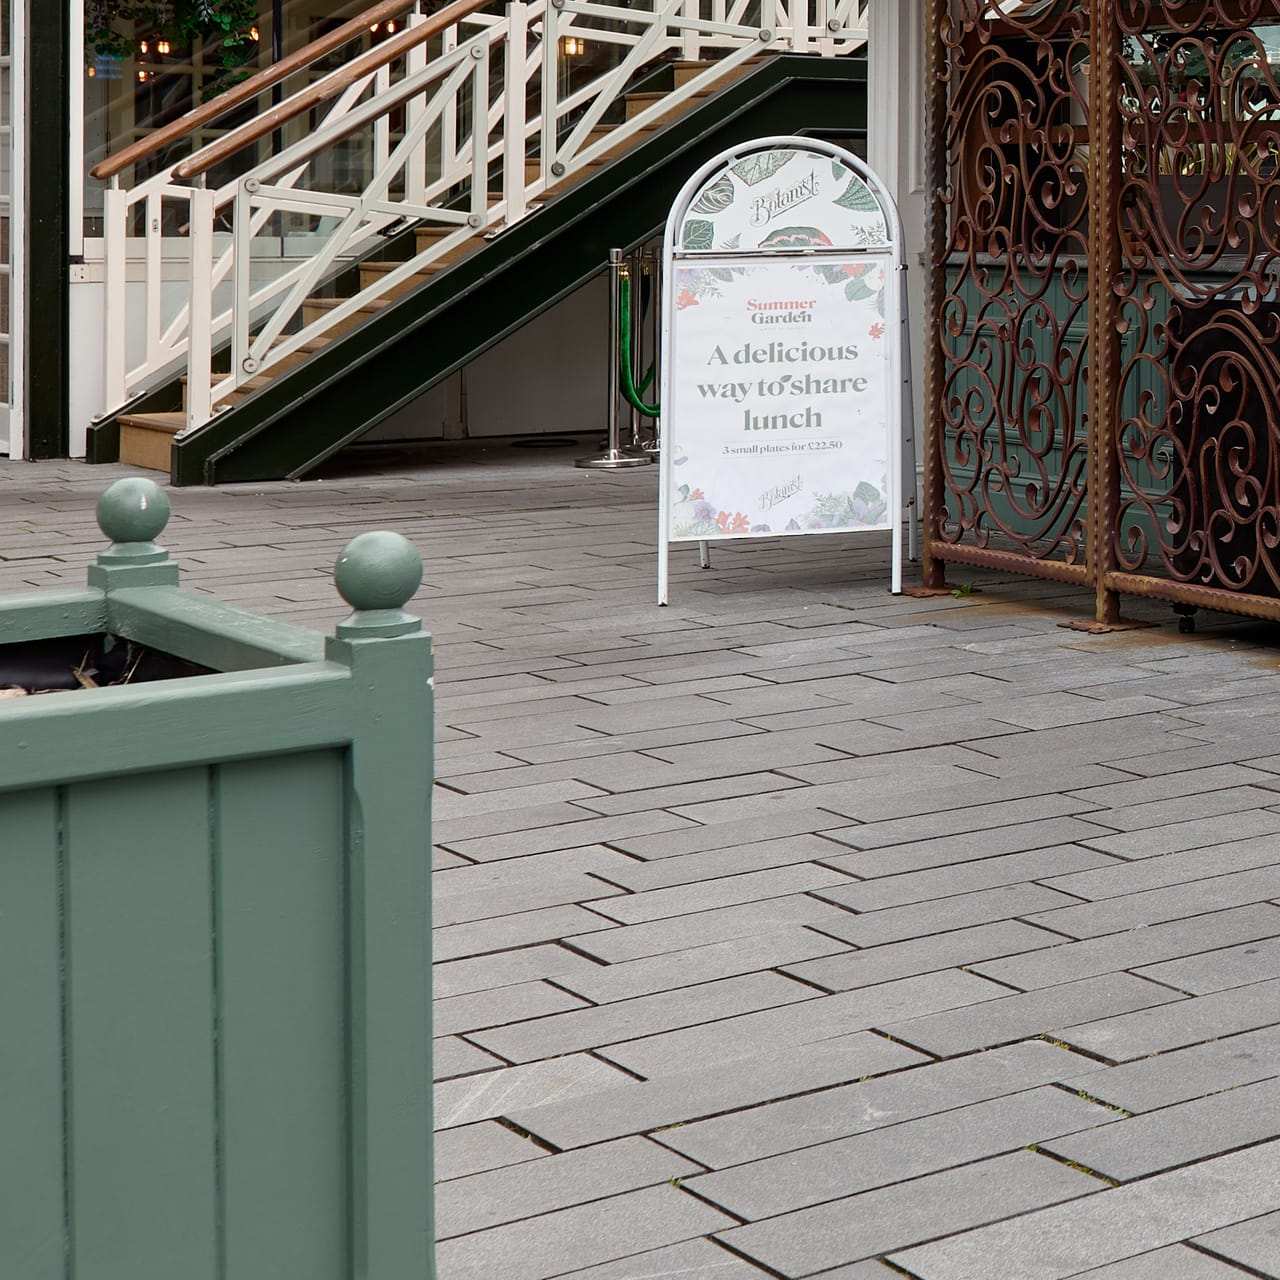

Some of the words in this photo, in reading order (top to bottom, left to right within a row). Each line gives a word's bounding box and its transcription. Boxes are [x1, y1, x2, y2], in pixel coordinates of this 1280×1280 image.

[750, 168, 820, 227] Botanist
[746, 299, 817, 312] Summer
[751, 311, 812, 325] Garden
[707, 345, 729, 366] A
[733, 341, 859, 365] delicious
[697, 382, 753, 403] way
[757, 378, 785, 397] to
[789, 373, 868, 396] share
[744, 406, 822, 431] lunch
[722, 446, 730, 455] 3
[731, 444, 758, 455] small
[759, 443, 790, 455] plates
[791, 441, 807, 451] for
